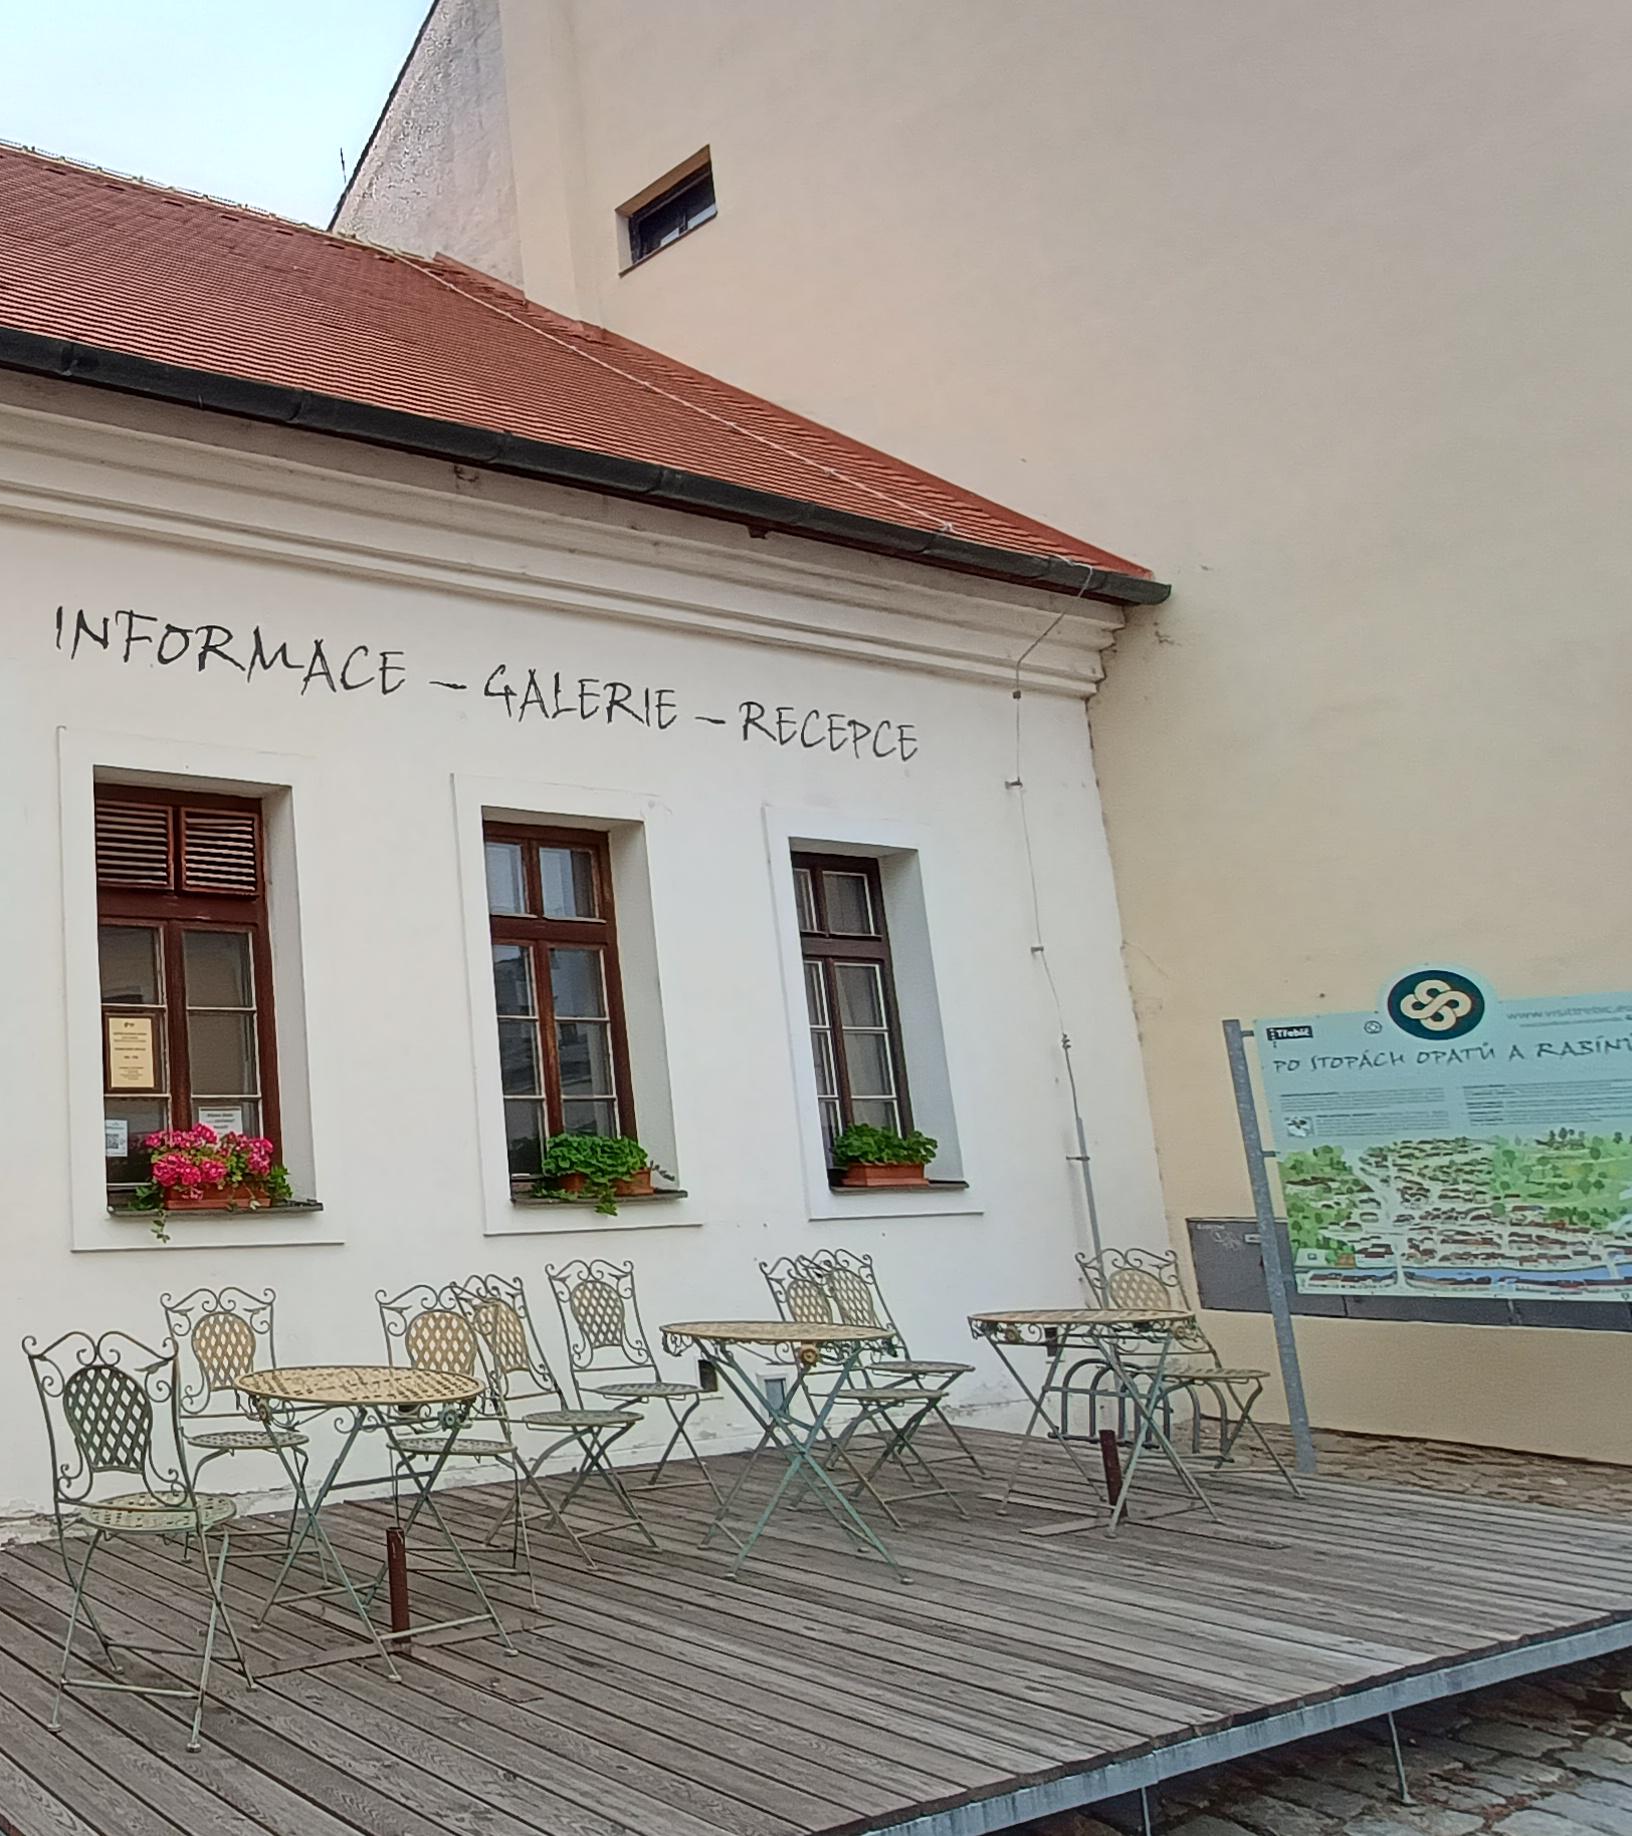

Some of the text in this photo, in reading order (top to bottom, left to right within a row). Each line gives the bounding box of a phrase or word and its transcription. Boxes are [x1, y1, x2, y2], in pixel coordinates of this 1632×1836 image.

[54, 605, 407, 697] INFORMACE
[483, 663, 679, 731] GALERIE
[738, 700, 920, 763] RECEPCE
[1272, 1059, 1301, 1074] PO
[1310, 1051, 1406, 1072] STOPÁCH
[1416, 1043, 1496, 1066] OPATŮ
[1508, 1044, 1526, 1061] A
